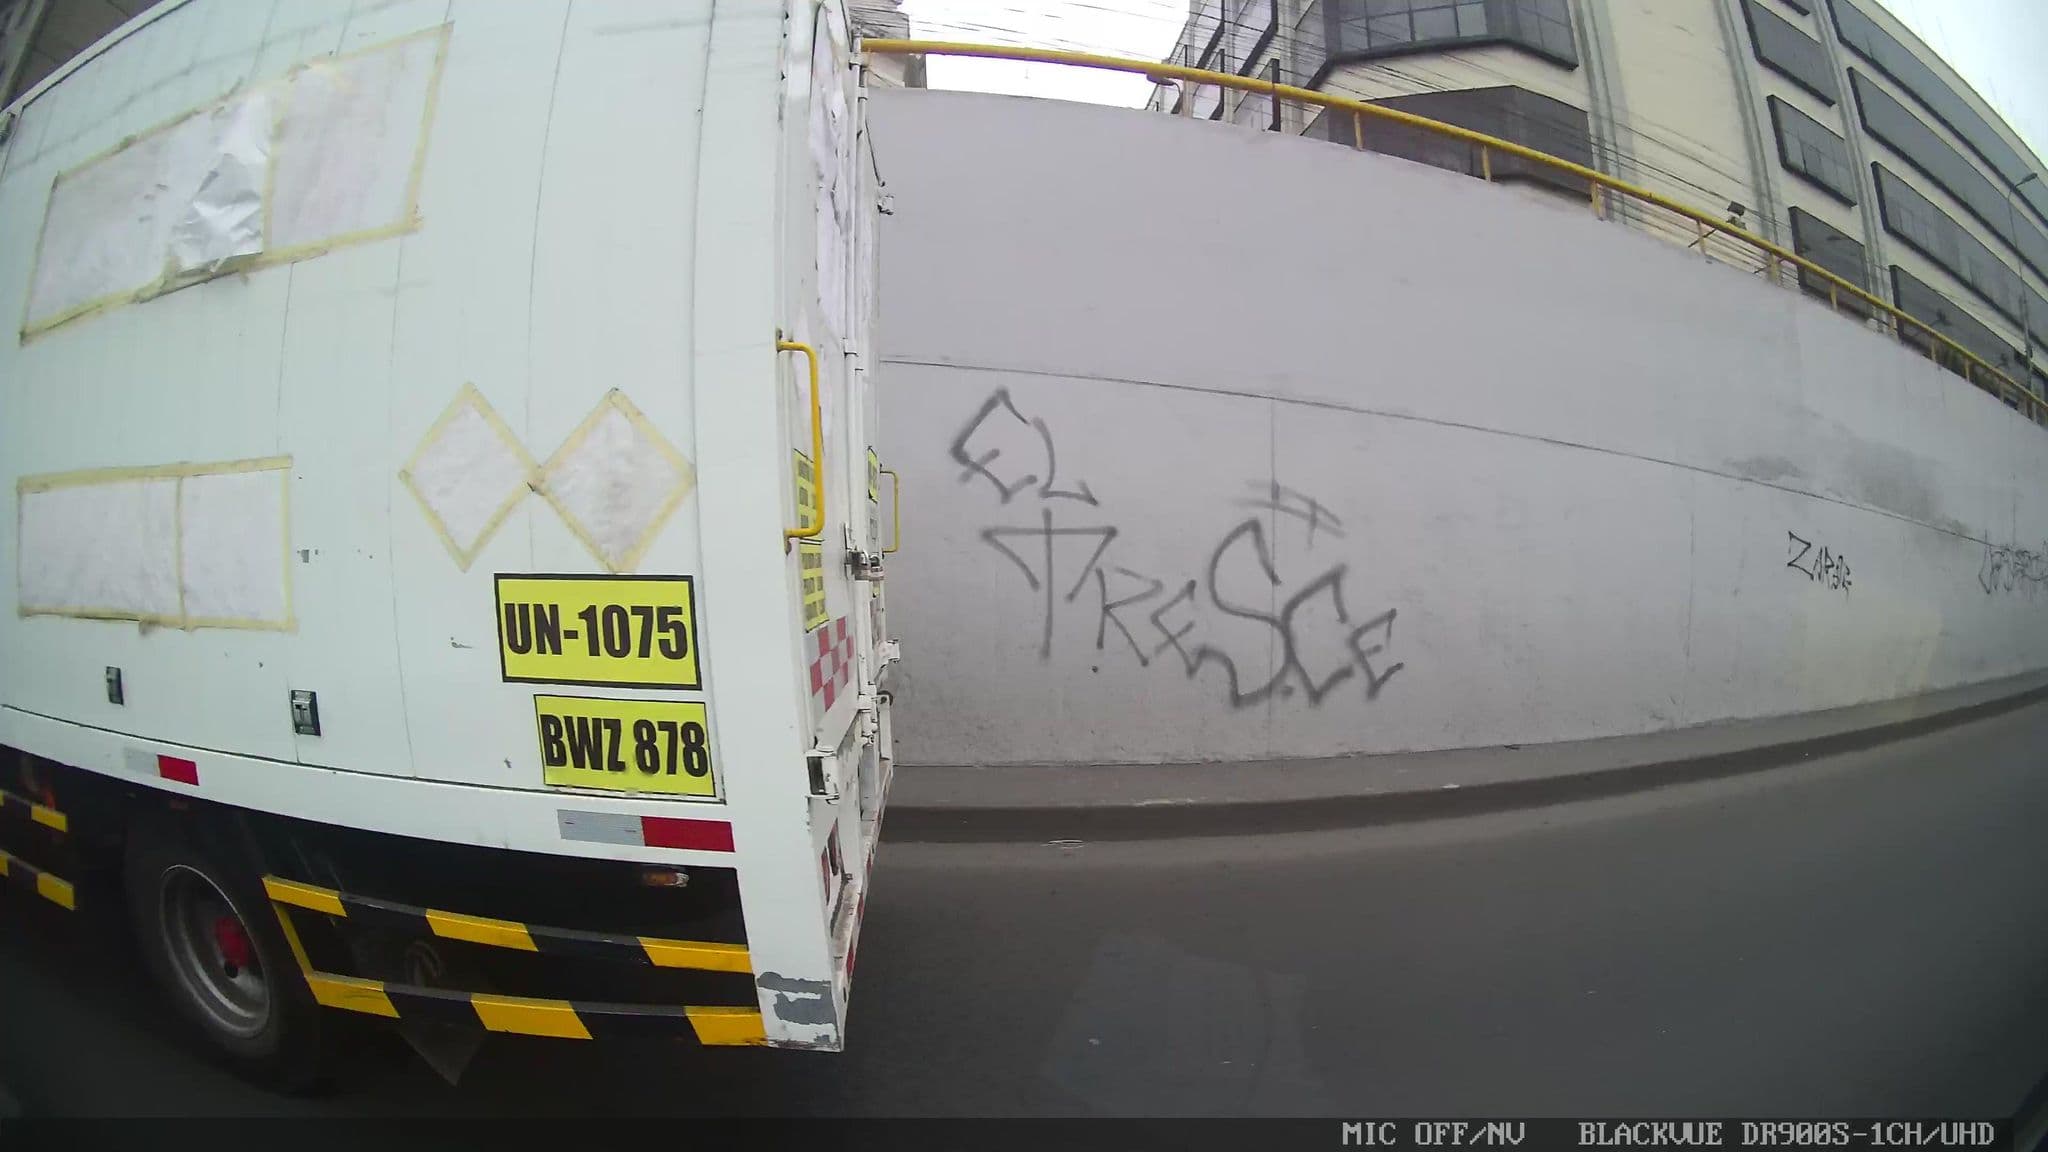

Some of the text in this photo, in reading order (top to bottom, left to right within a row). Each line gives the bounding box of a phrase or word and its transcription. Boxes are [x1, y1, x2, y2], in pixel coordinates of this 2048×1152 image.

[504, 603, 688, 660] UN-1075
[540, 714, 708, 777] BWZ 878
